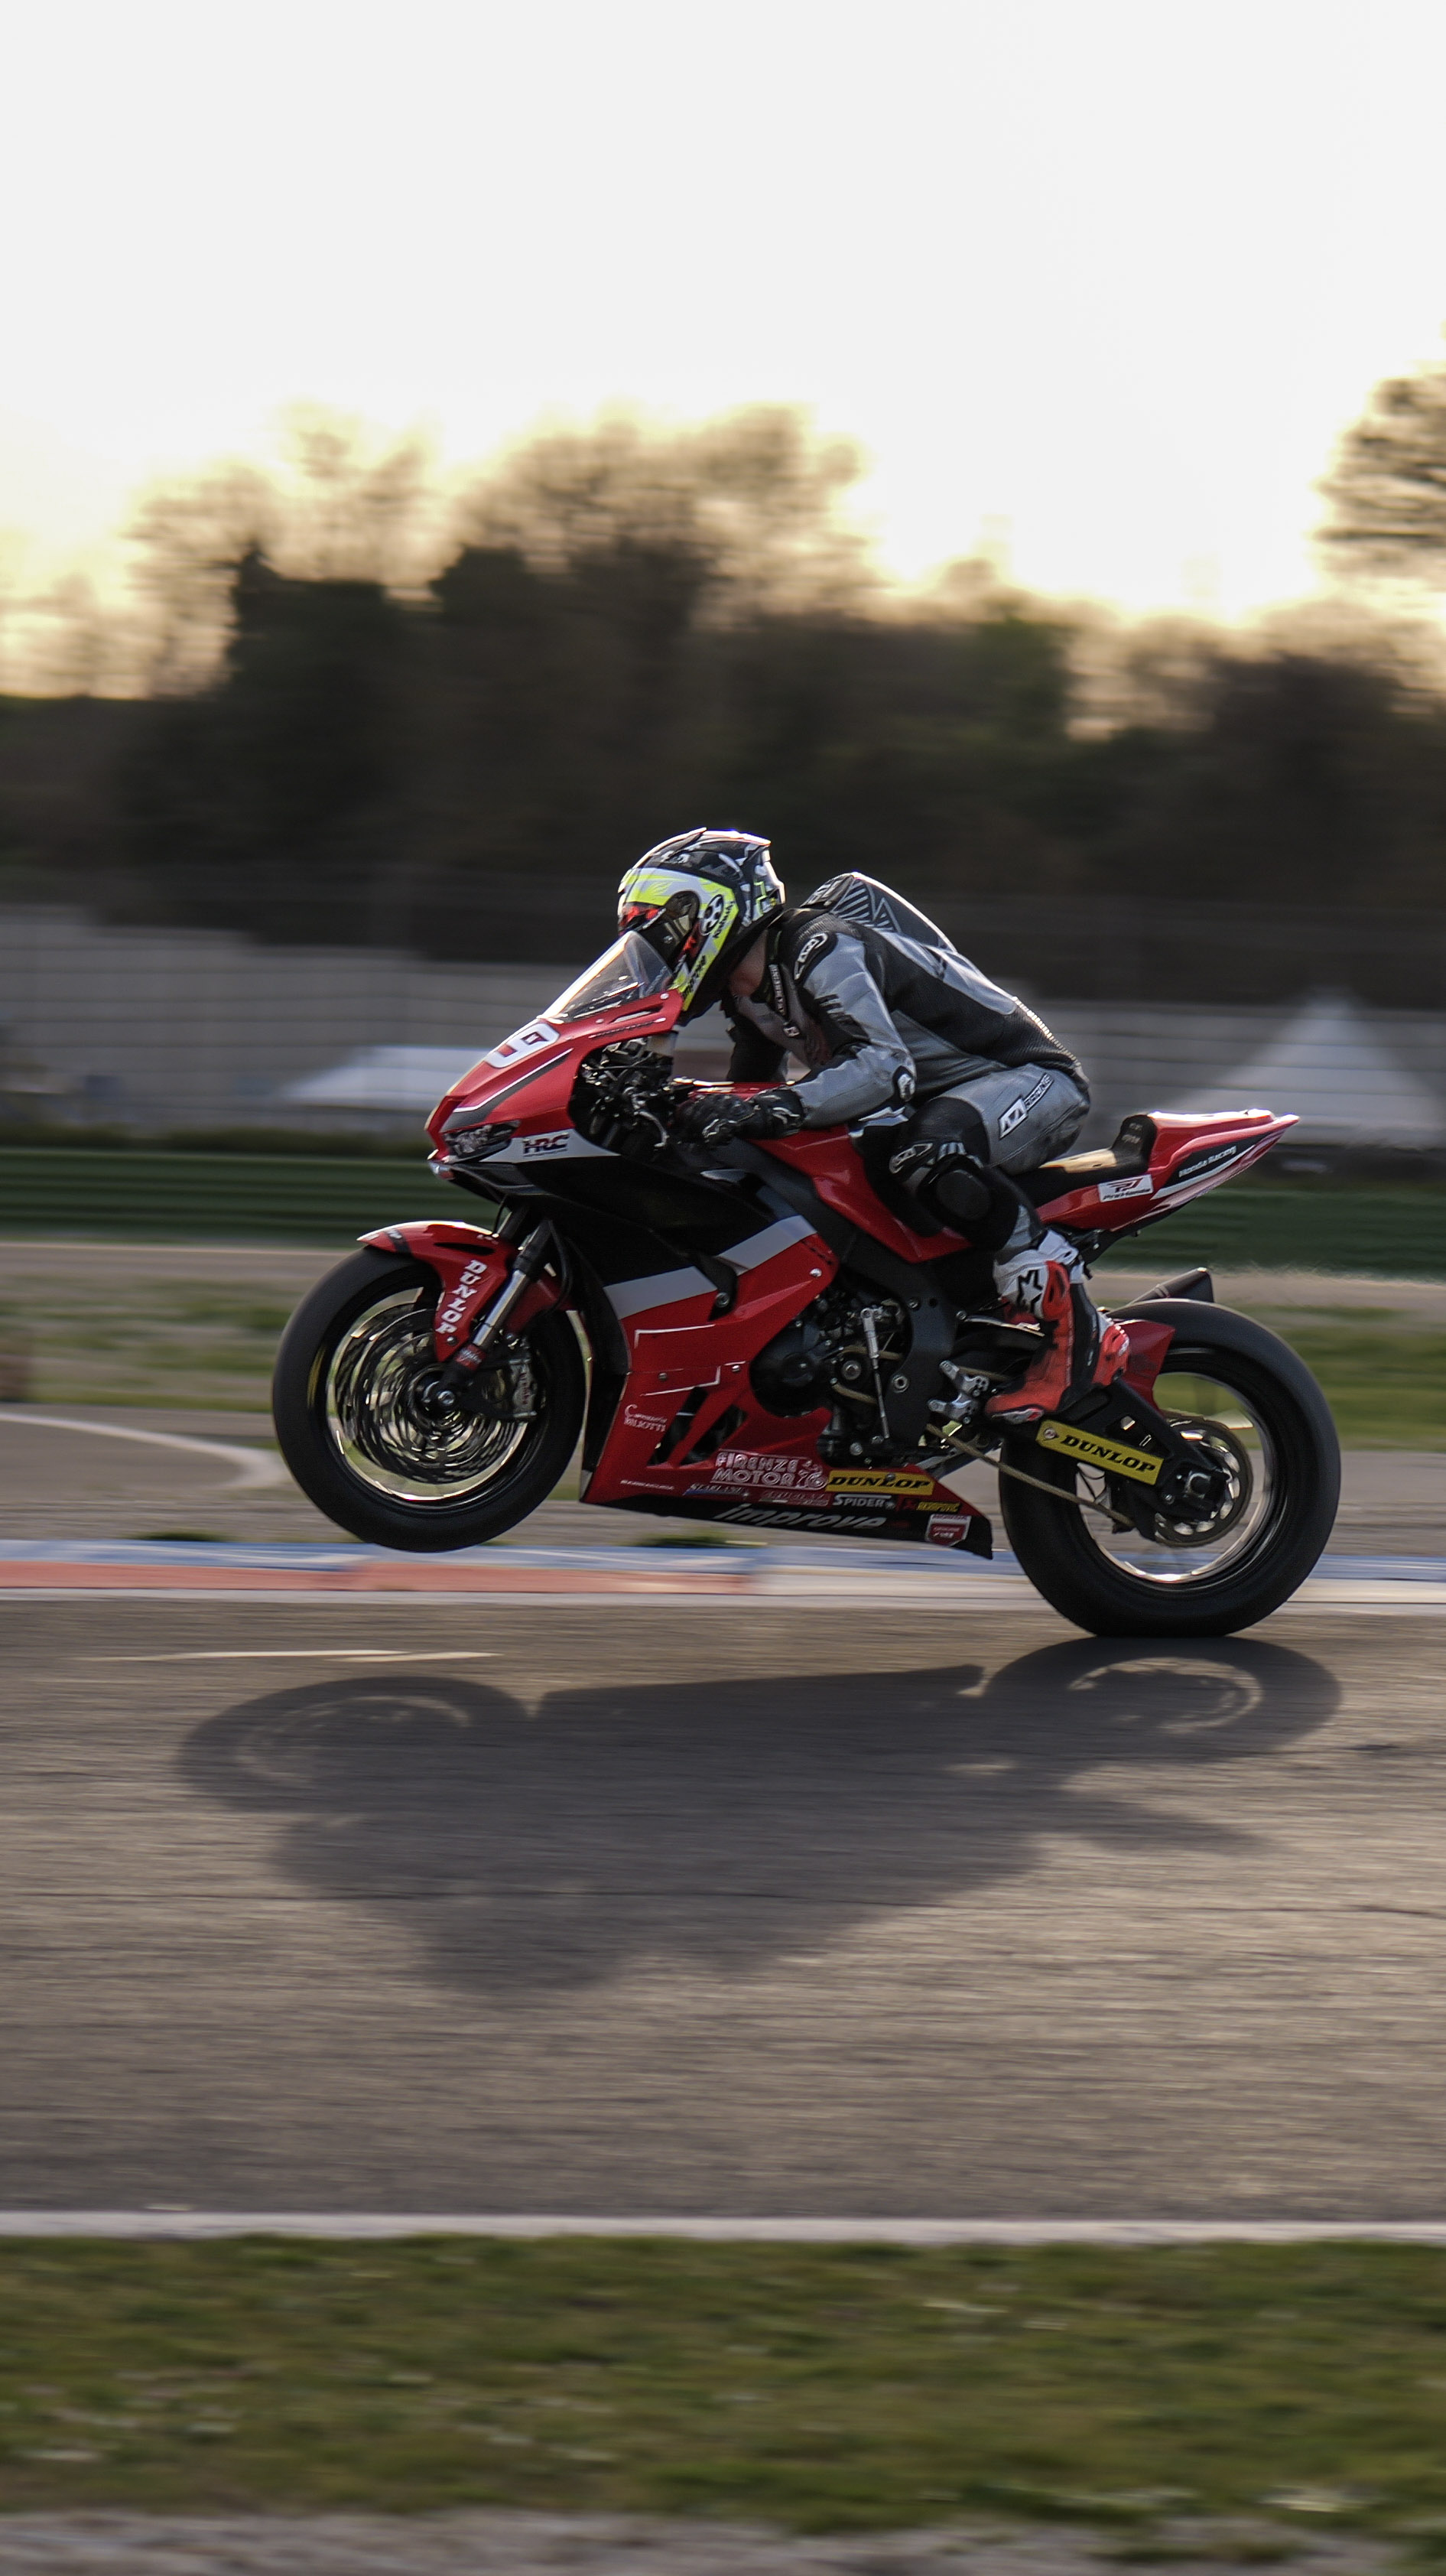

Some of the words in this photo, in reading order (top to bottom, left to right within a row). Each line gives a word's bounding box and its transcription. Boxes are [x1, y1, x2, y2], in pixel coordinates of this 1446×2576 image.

[523, 1134, 570, 1153] HRC
[1178, 1160, 1207, 1178] Honda
[1207, 1146, 1236, 1164] Racing
[435, 1260, 488, 1334] DUNLOP
[715, 1452, 800, 1472] FIRENZE
[1061, 1435, 1156, 1472] DUNLOP
[711, 1468, 796, 1486] MOTOR
[827, 1476, 931, 1488] DUNLOP
[833, 1494, 887, 1508] SPIDER
[711, 1503, 887, 1529] improve
